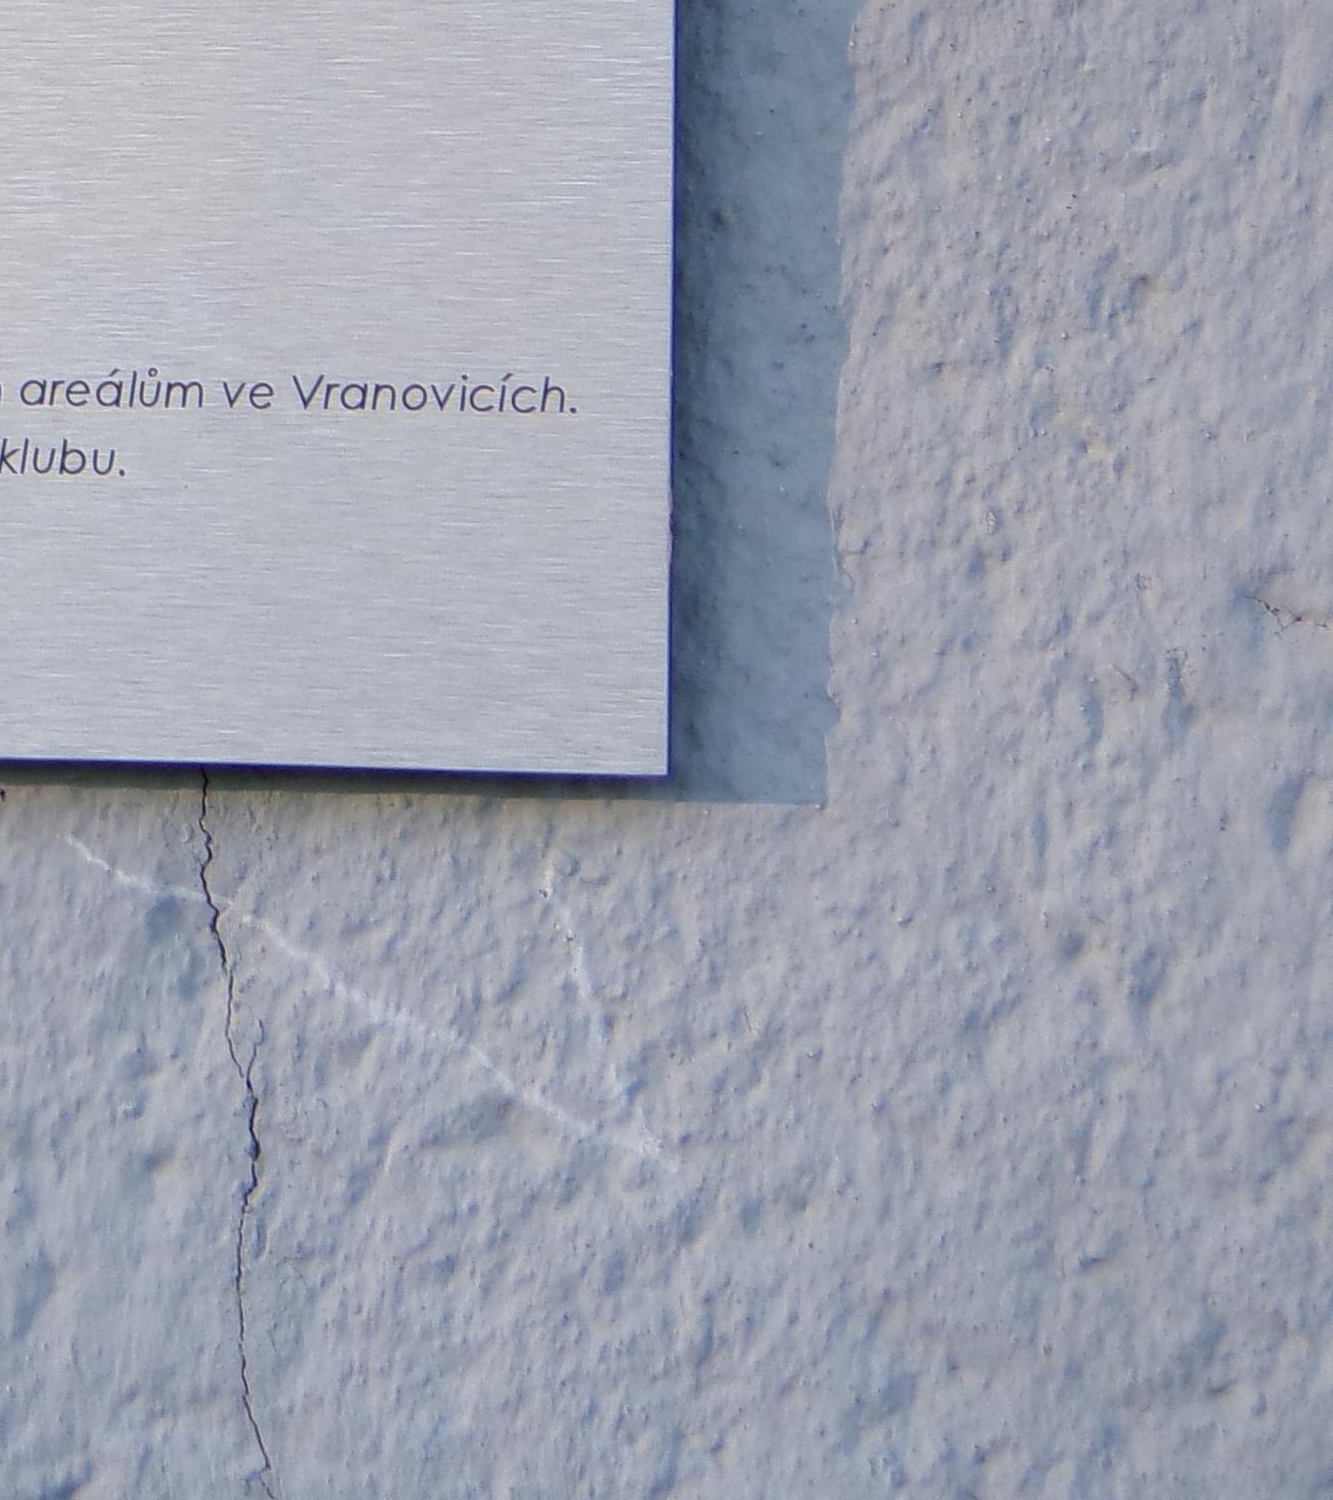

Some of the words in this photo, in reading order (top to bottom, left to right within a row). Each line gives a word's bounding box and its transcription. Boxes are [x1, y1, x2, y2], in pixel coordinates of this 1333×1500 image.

[19, 367, 204, 408] areálům
[222, 381, 274, 410] ve
[292, 372, 577, 414] Vranovicích.
